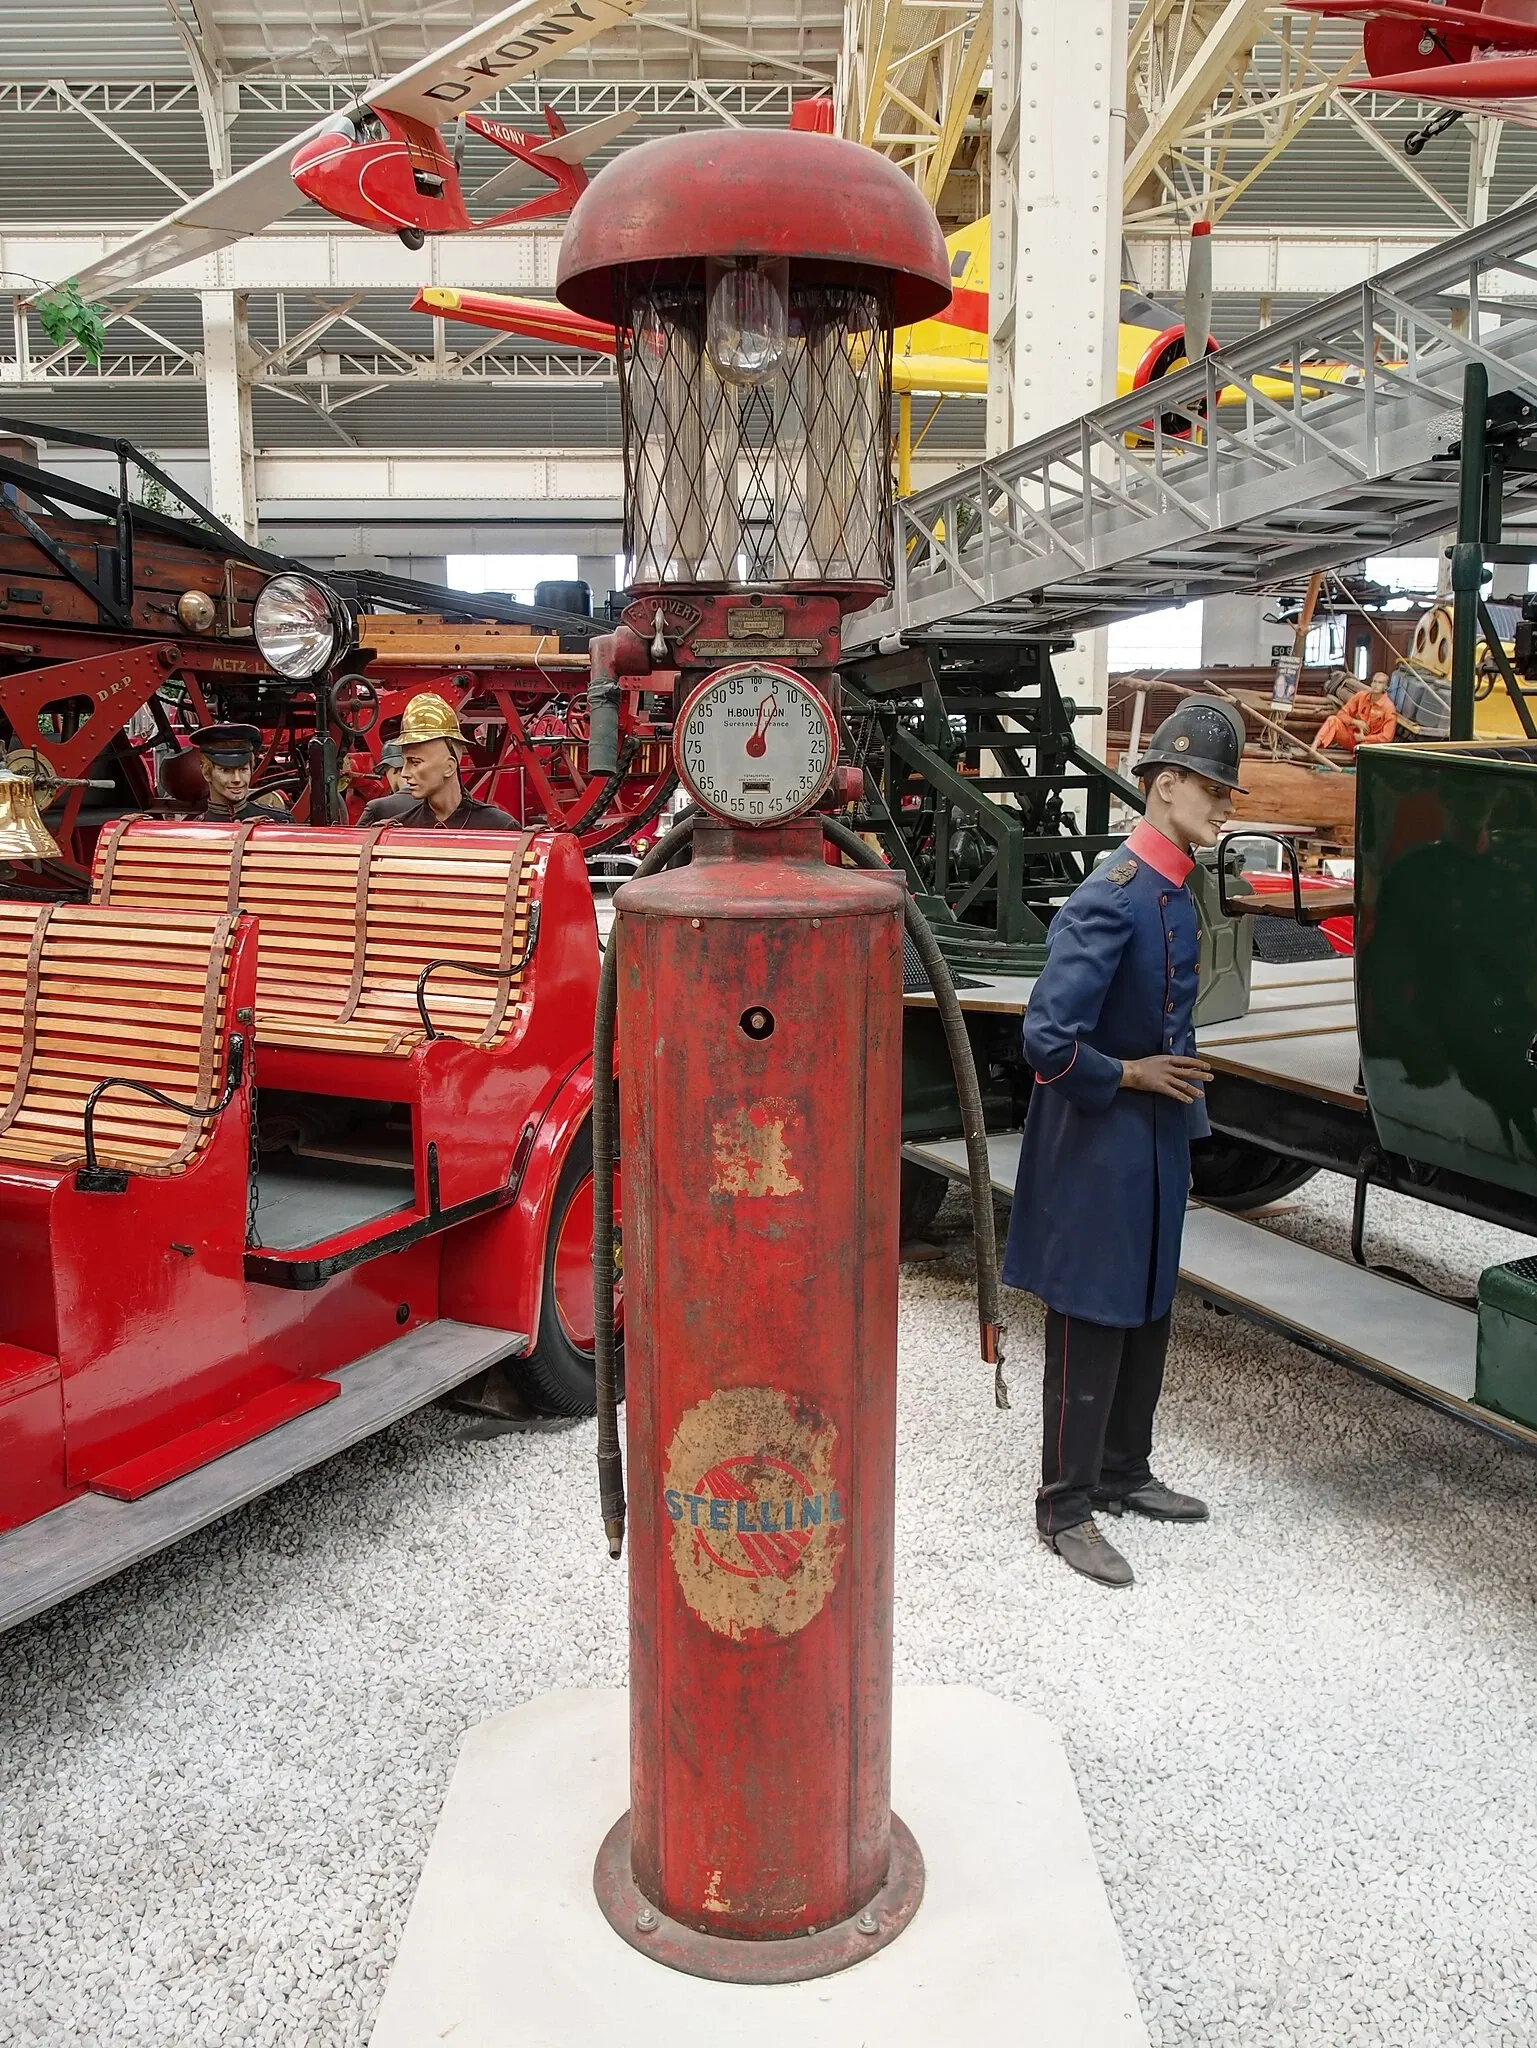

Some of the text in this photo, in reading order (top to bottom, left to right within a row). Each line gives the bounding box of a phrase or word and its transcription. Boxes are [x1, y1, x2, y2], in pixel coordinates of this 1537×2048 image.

[422, 1, 596, 103] D-KONY
[481, 119, 526, 147] D-KONY
[651, 599, 700, 622] OUVERT
[729, 681, 744, 695] 95
[751, 677, 763, 685] 100
[771, 681, 779, 695] 5
[712, 690, 727, 704] 90
[787, 690, 798, 704] 10
[698, 704, 713, 718] 85
[727, 708, 785, 718] H.BOUTLLON
[800, 704, 812, 718] 15
[689, 721, 705, 735] 80
[808, 721, 823, 735] 20
[687, 740, 702, 754] 75
[811, 740, 825, 754] 25
[690, 759, 705, 773] 70
[808, 759, 822, 773] 30
[699, 776, 714, 790] 65
[799, 776, 813, 790] 35
[713, 790, 728, 803] 60
[785, 790, 800, 803] 40
[730, 798, 745, 812] 55
[749, 801, 764, 815] 50
[768, 798, 783, 812] 45
[663, 1488, 844, 1533] STELLINE
